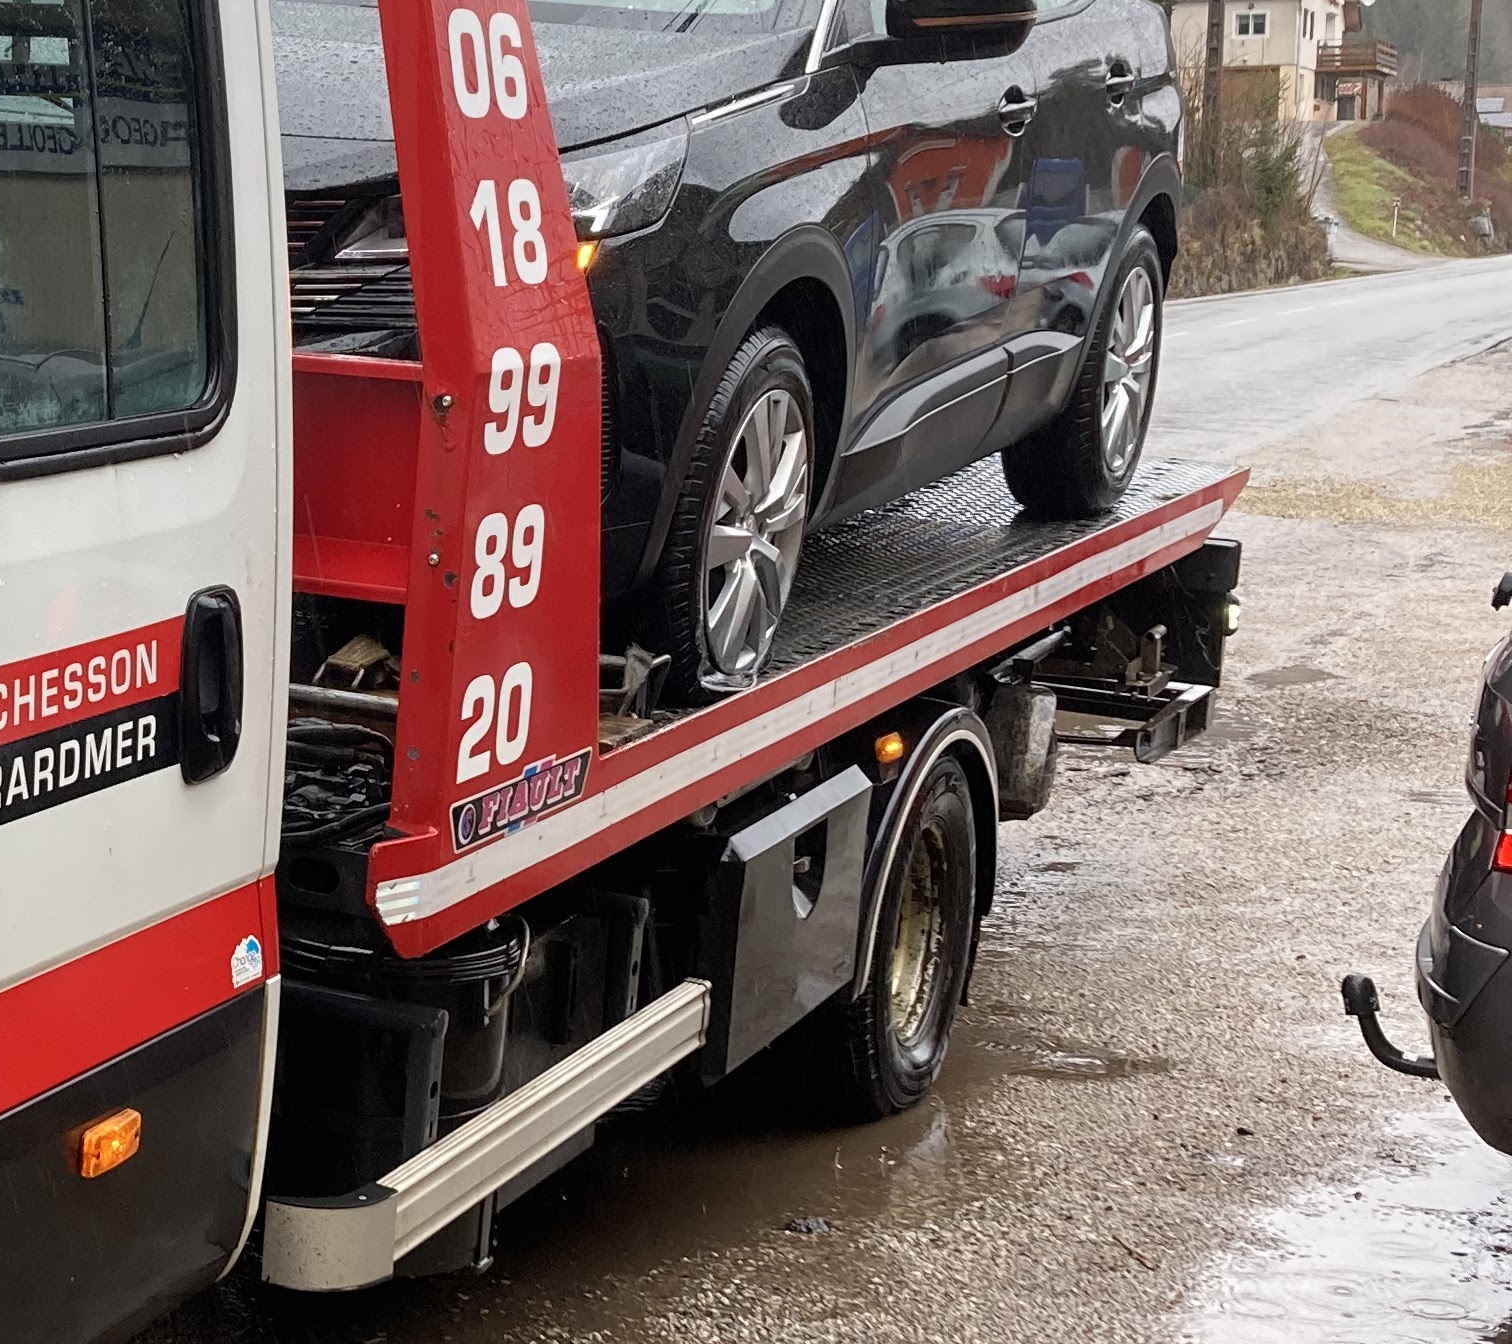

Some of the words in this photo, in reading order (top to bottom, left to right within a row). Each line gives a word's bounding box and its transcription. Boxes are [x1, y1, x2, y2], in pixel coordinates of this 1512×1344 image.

[447, 8, 528, 120] 06
[469, 178, 548, 287] 18
[484, 342, 561, 455] 99
[470, 503, 545, 620] 89
[455, 661, 533, 784] 20
[478, 756, 582, 836] FIAULT
